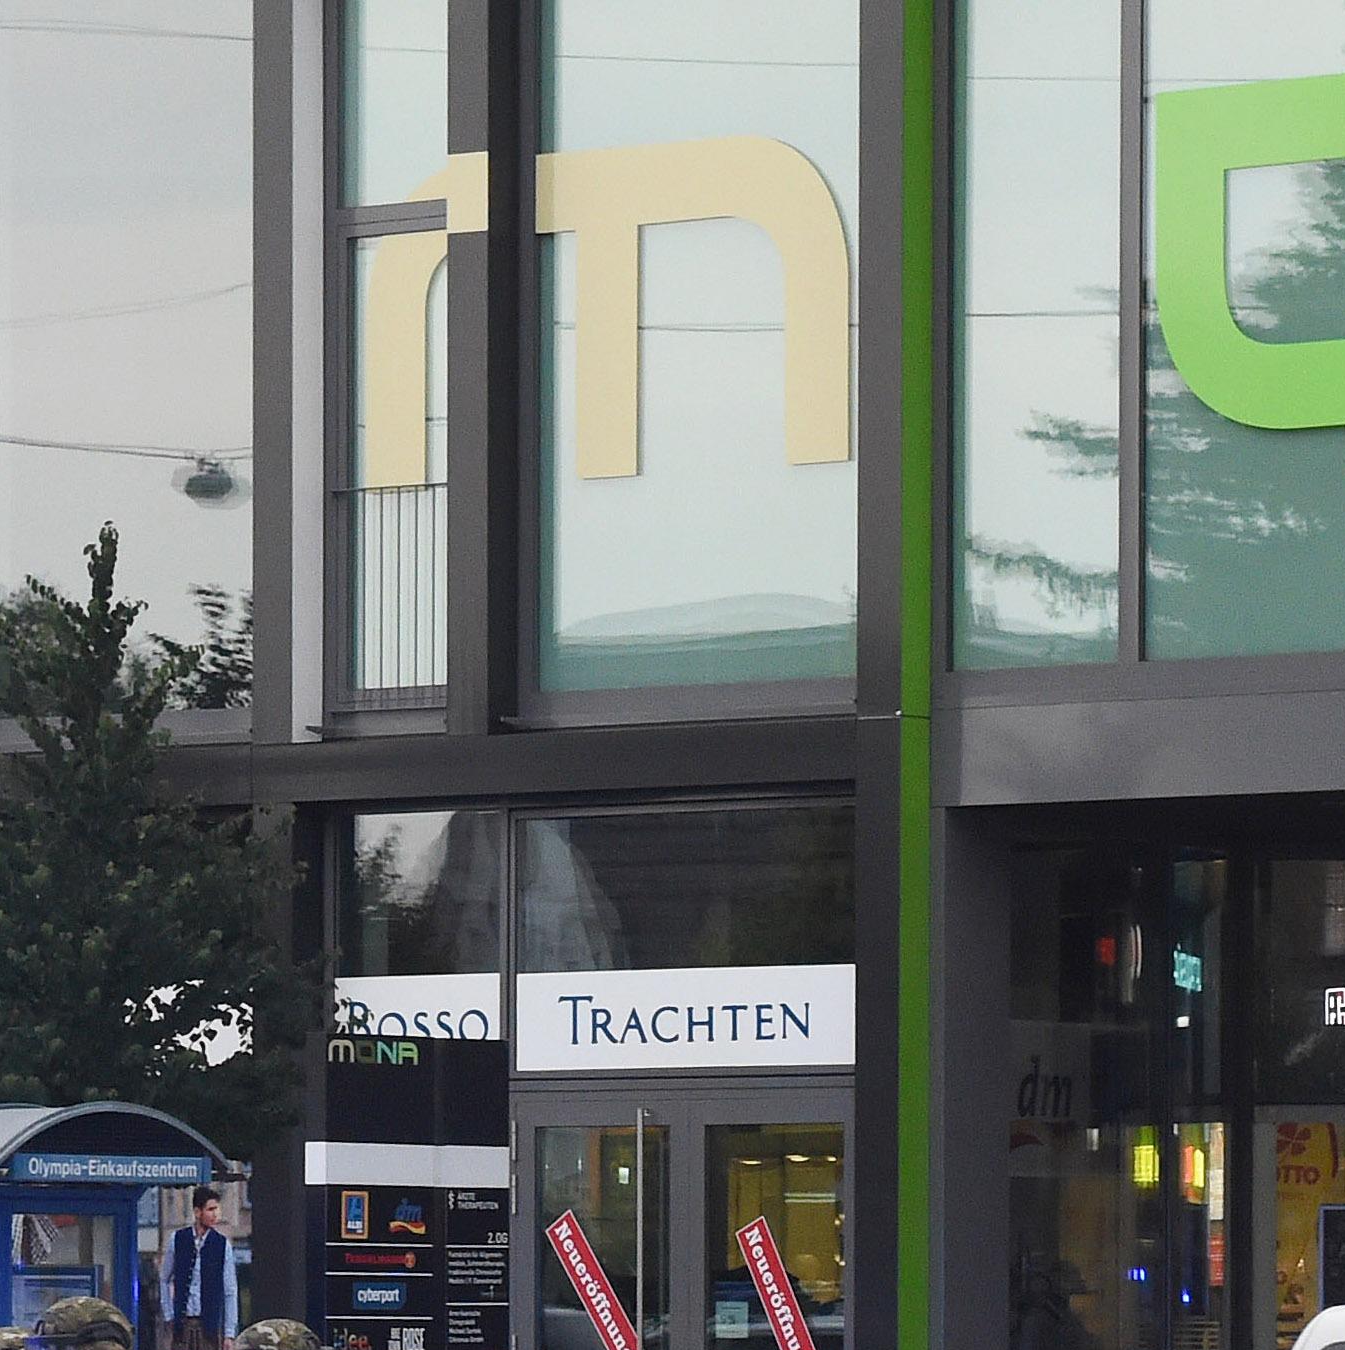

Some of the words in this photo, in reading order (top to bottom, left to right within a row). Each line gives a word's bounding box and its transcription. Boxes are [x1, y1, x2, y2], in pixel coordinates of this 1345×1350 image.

[558, 994, 812, 1046] TRACHTEN
[1017, 1056, 1072, 1118] dm
[27, 1156, 198, 1180] Olympia-Einkaufszentrum
[357, 1287, 400, 1304] cyberport
